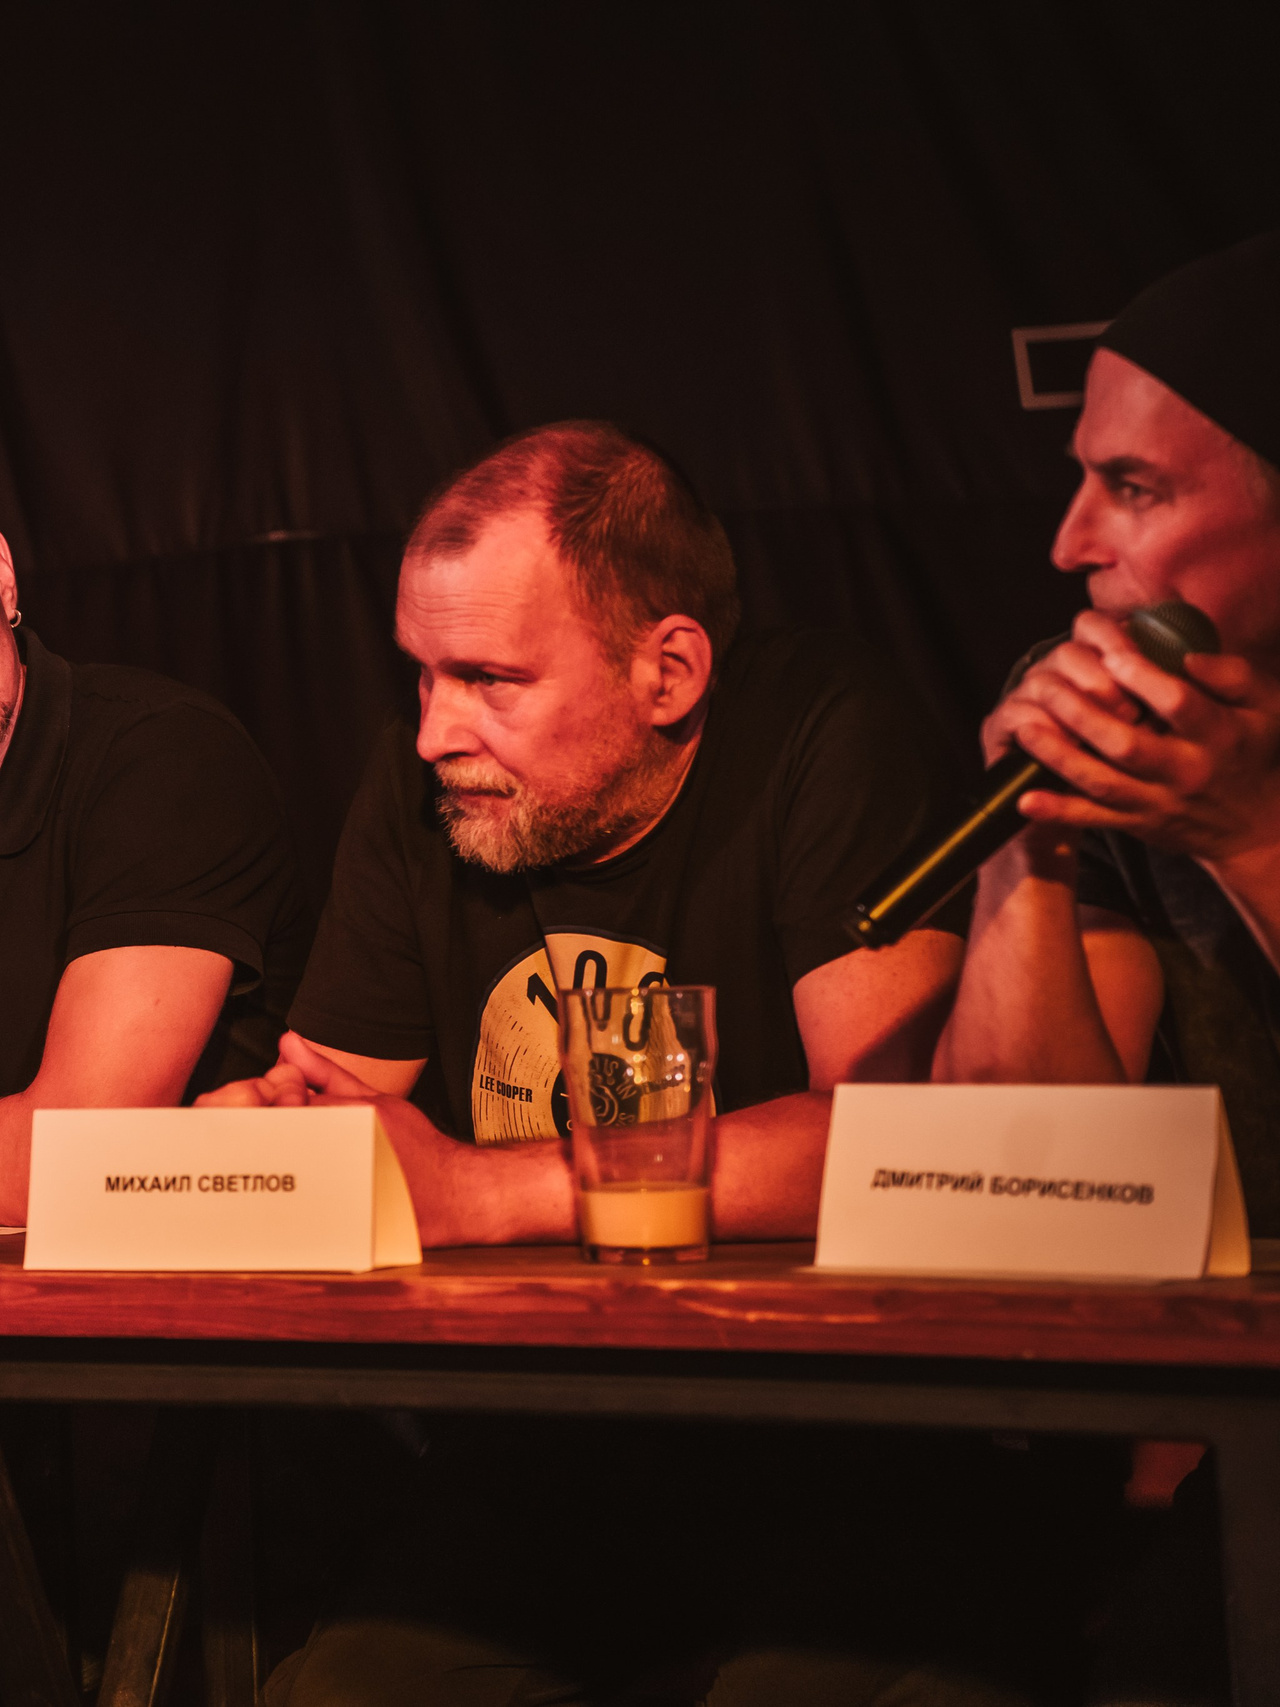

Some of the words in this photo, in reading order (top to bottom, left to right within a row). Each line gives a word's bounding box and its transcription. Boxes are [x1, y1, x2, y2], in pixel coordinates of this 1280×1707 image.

[480, 1074, 495, 1093] LEE
[496, 1080, 533, 1103] COOPER
[105, 1174, 192, 1193] МИХАИЛ
[197, 1174, 296, 1193] СВЕТЛОВ
[869, 1168, 985, 1193] ДМИТРИЙ
[989, 1175, 1156, 1206] БОРИСЕНКОВ
